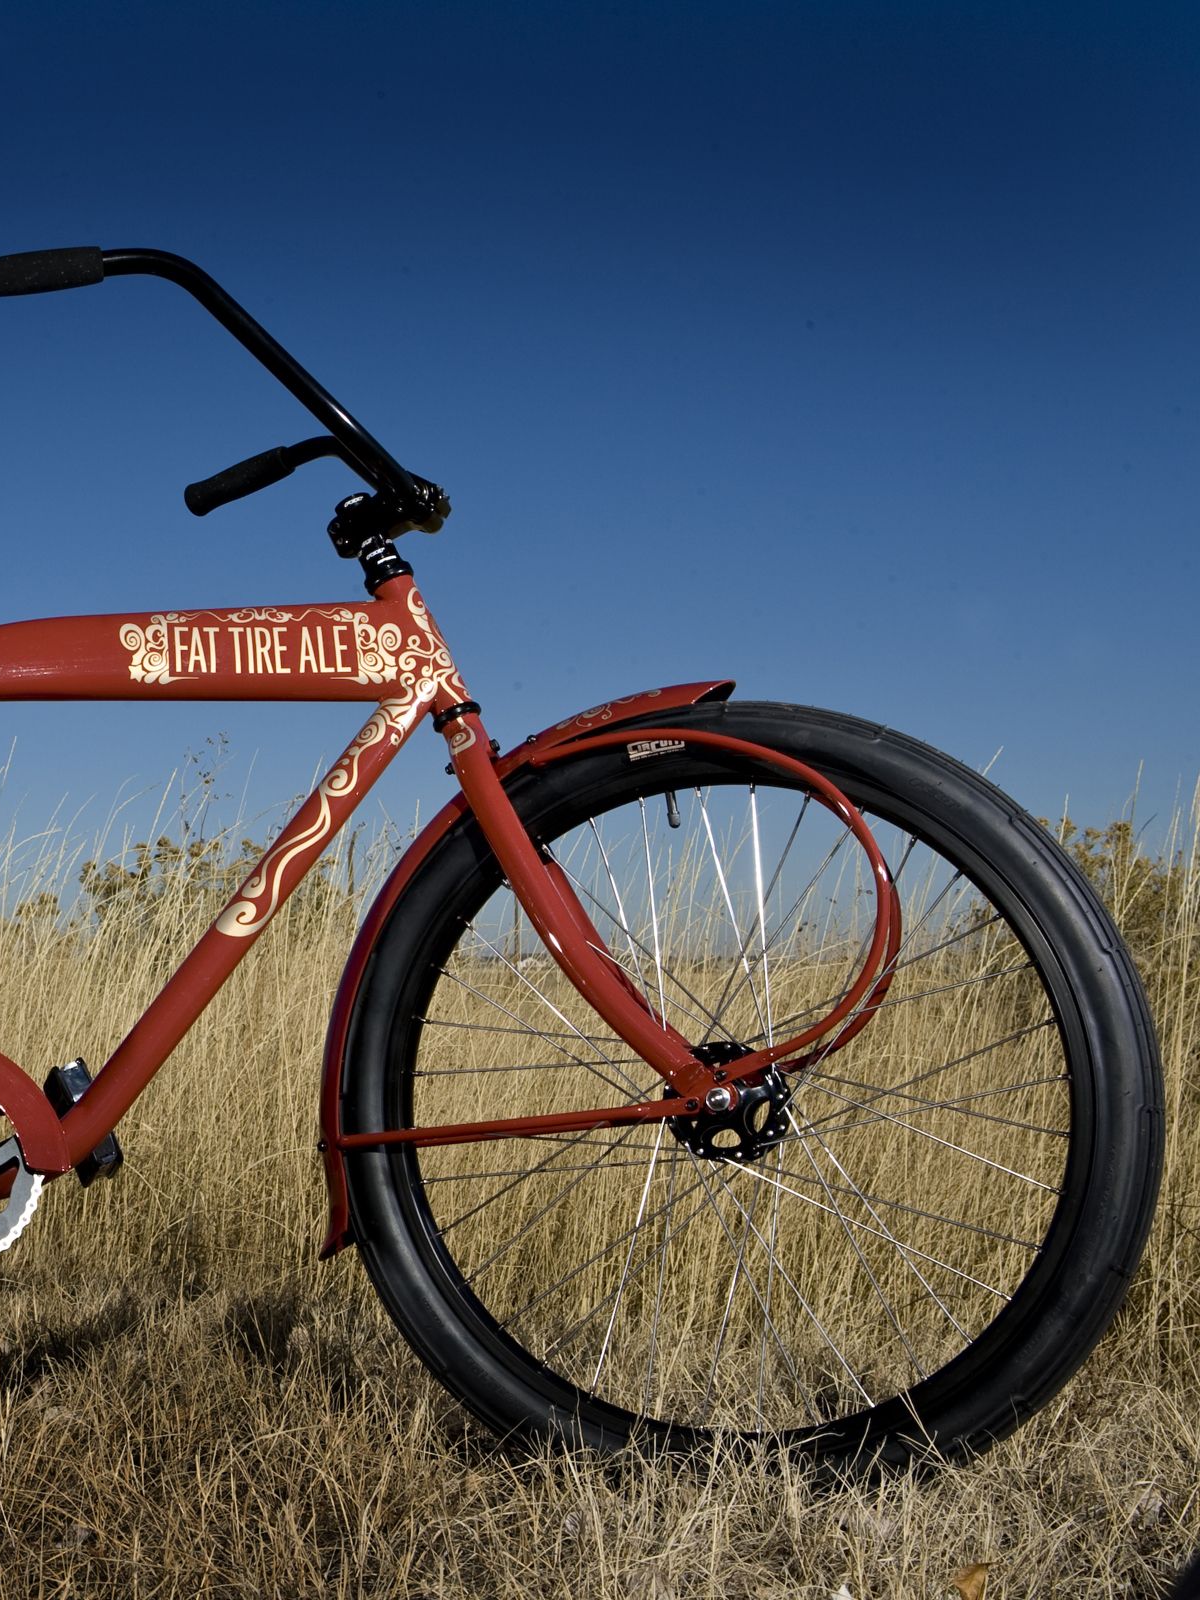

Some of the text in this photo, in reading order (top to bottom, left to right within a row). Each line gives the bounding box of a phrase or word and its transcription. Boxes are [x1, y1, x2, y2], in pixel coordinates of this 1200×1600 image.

[174, 625, 352, 674] FAT TIRE ALE
